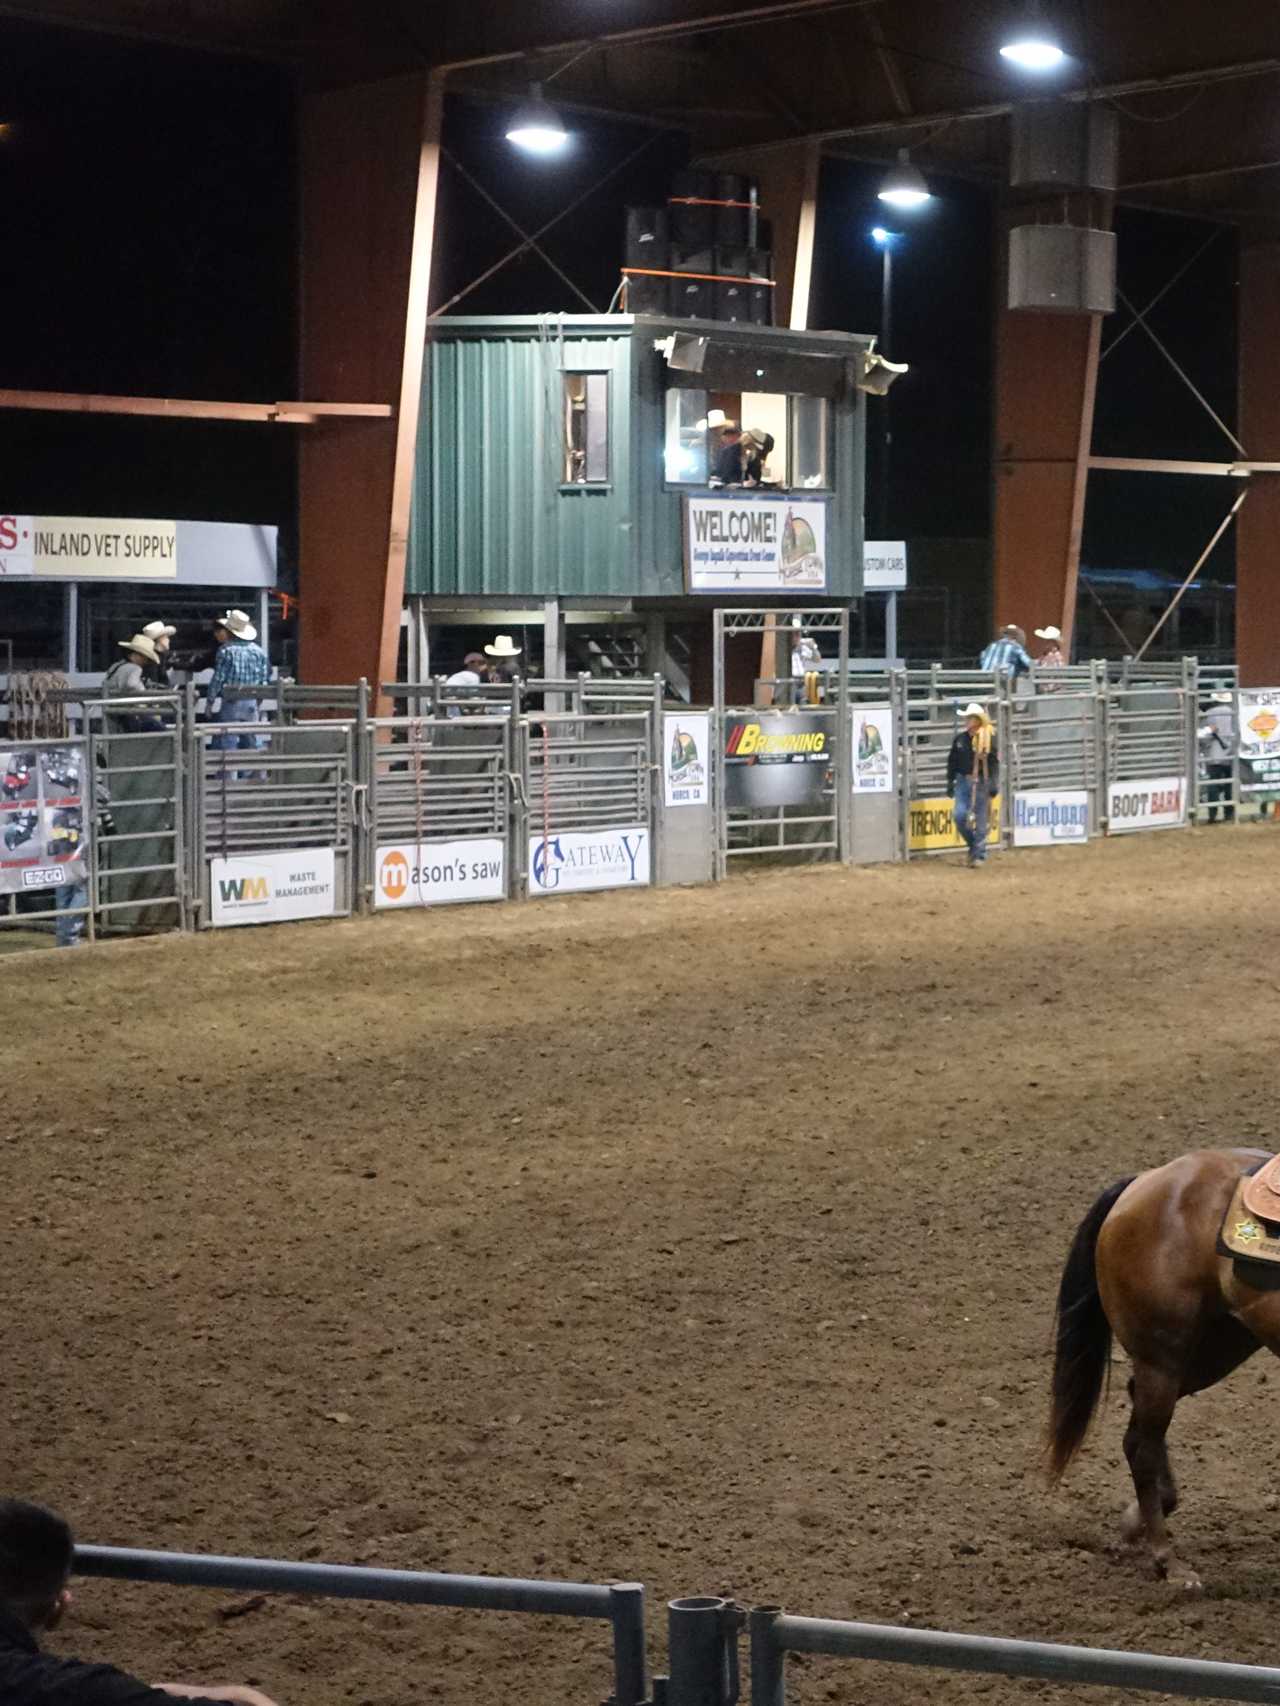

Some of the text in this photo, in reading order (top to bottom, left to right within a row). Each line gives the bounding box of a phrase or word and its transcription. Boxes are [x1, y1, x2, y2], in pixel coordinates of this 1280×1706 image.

[693, 510, 777, 543] WELCOME!
[34, 532, 176, 558] INLAND VET SUPPLY
[1112, 793, 1148, 818] BOOT
[911, 810, 952, 837] TRENCH
[471, 860, 501, 880] saw
[533, 834, 644, 888] GATEWAY
[289, 872, 316, 882] WASTE
[275, 884, 330, 898] MANAGEMENT
